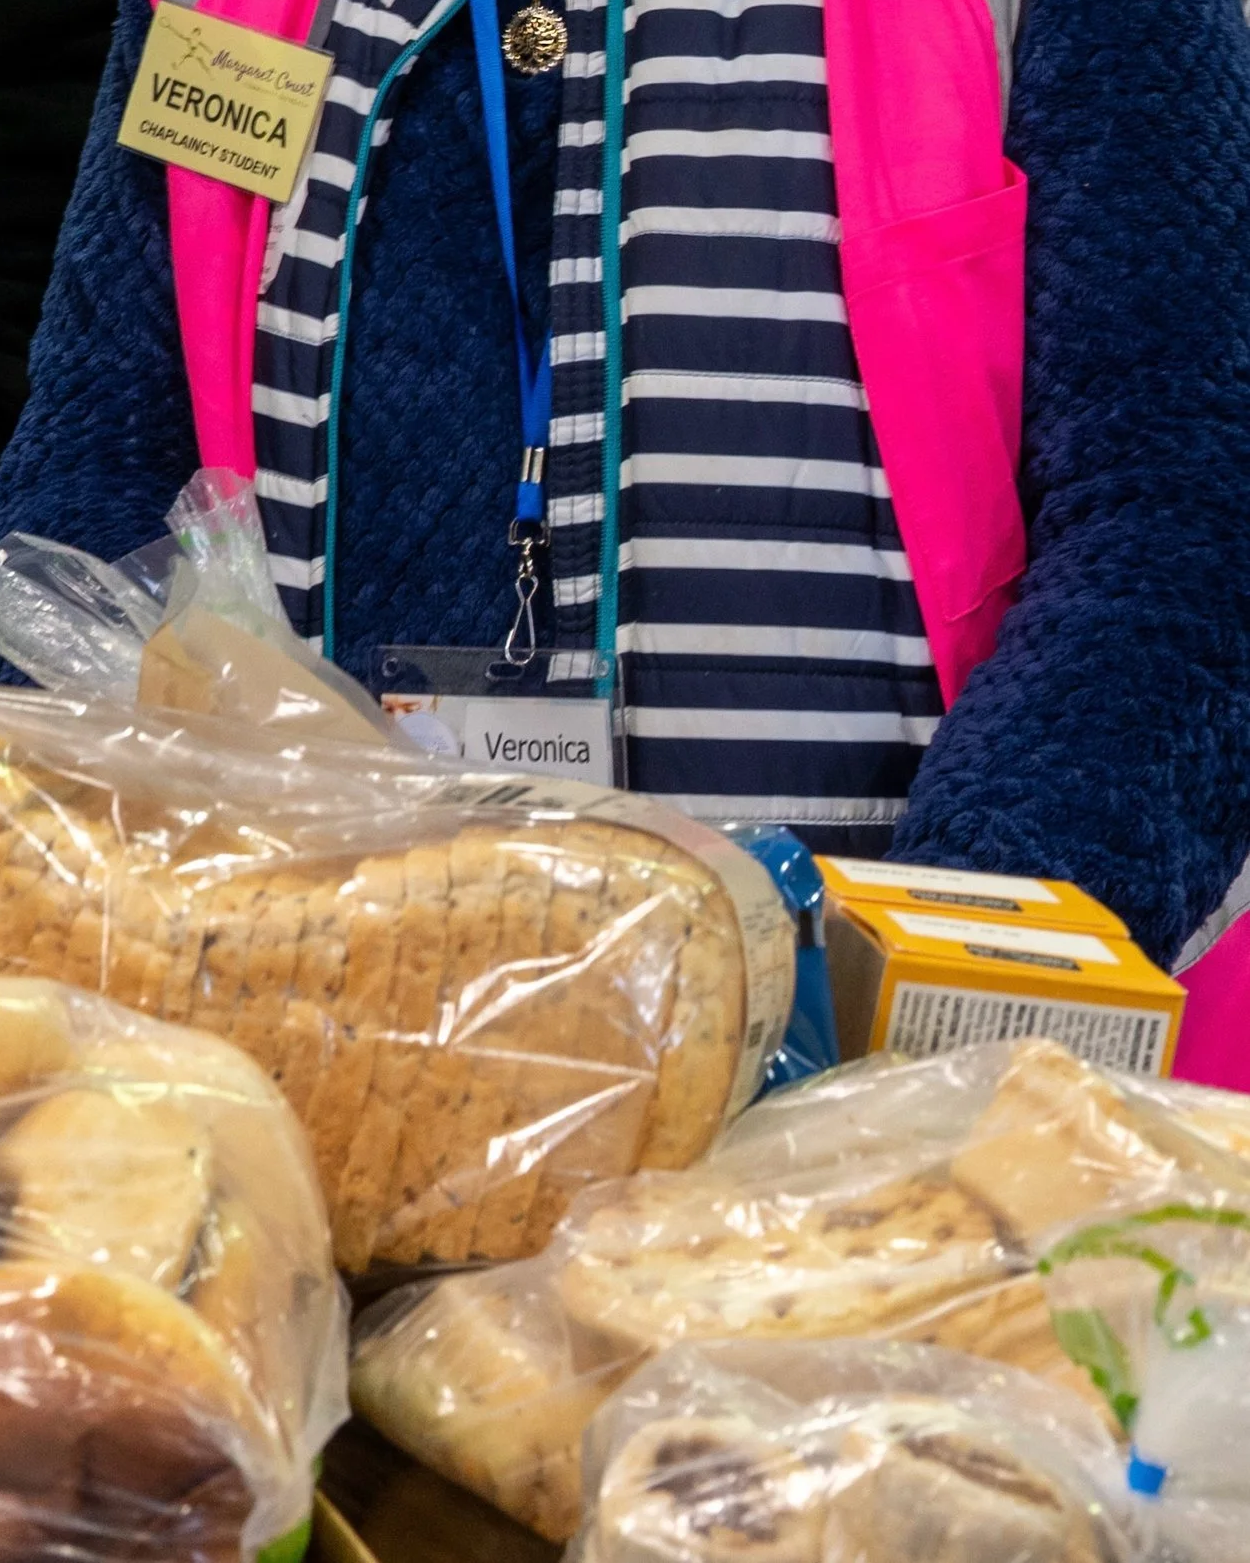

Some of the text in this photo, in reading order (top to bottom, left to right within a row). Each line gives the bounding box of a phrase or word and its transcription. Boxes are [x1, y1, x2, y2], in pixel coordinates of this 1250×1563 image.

[210, 49, 275, 83] Margaret
[150, 72, 288, 149] VERONICA
[139, 120, 281, 180] CHAPLAINCY STUDENT
[484, 730, 591, 764] Veronica
